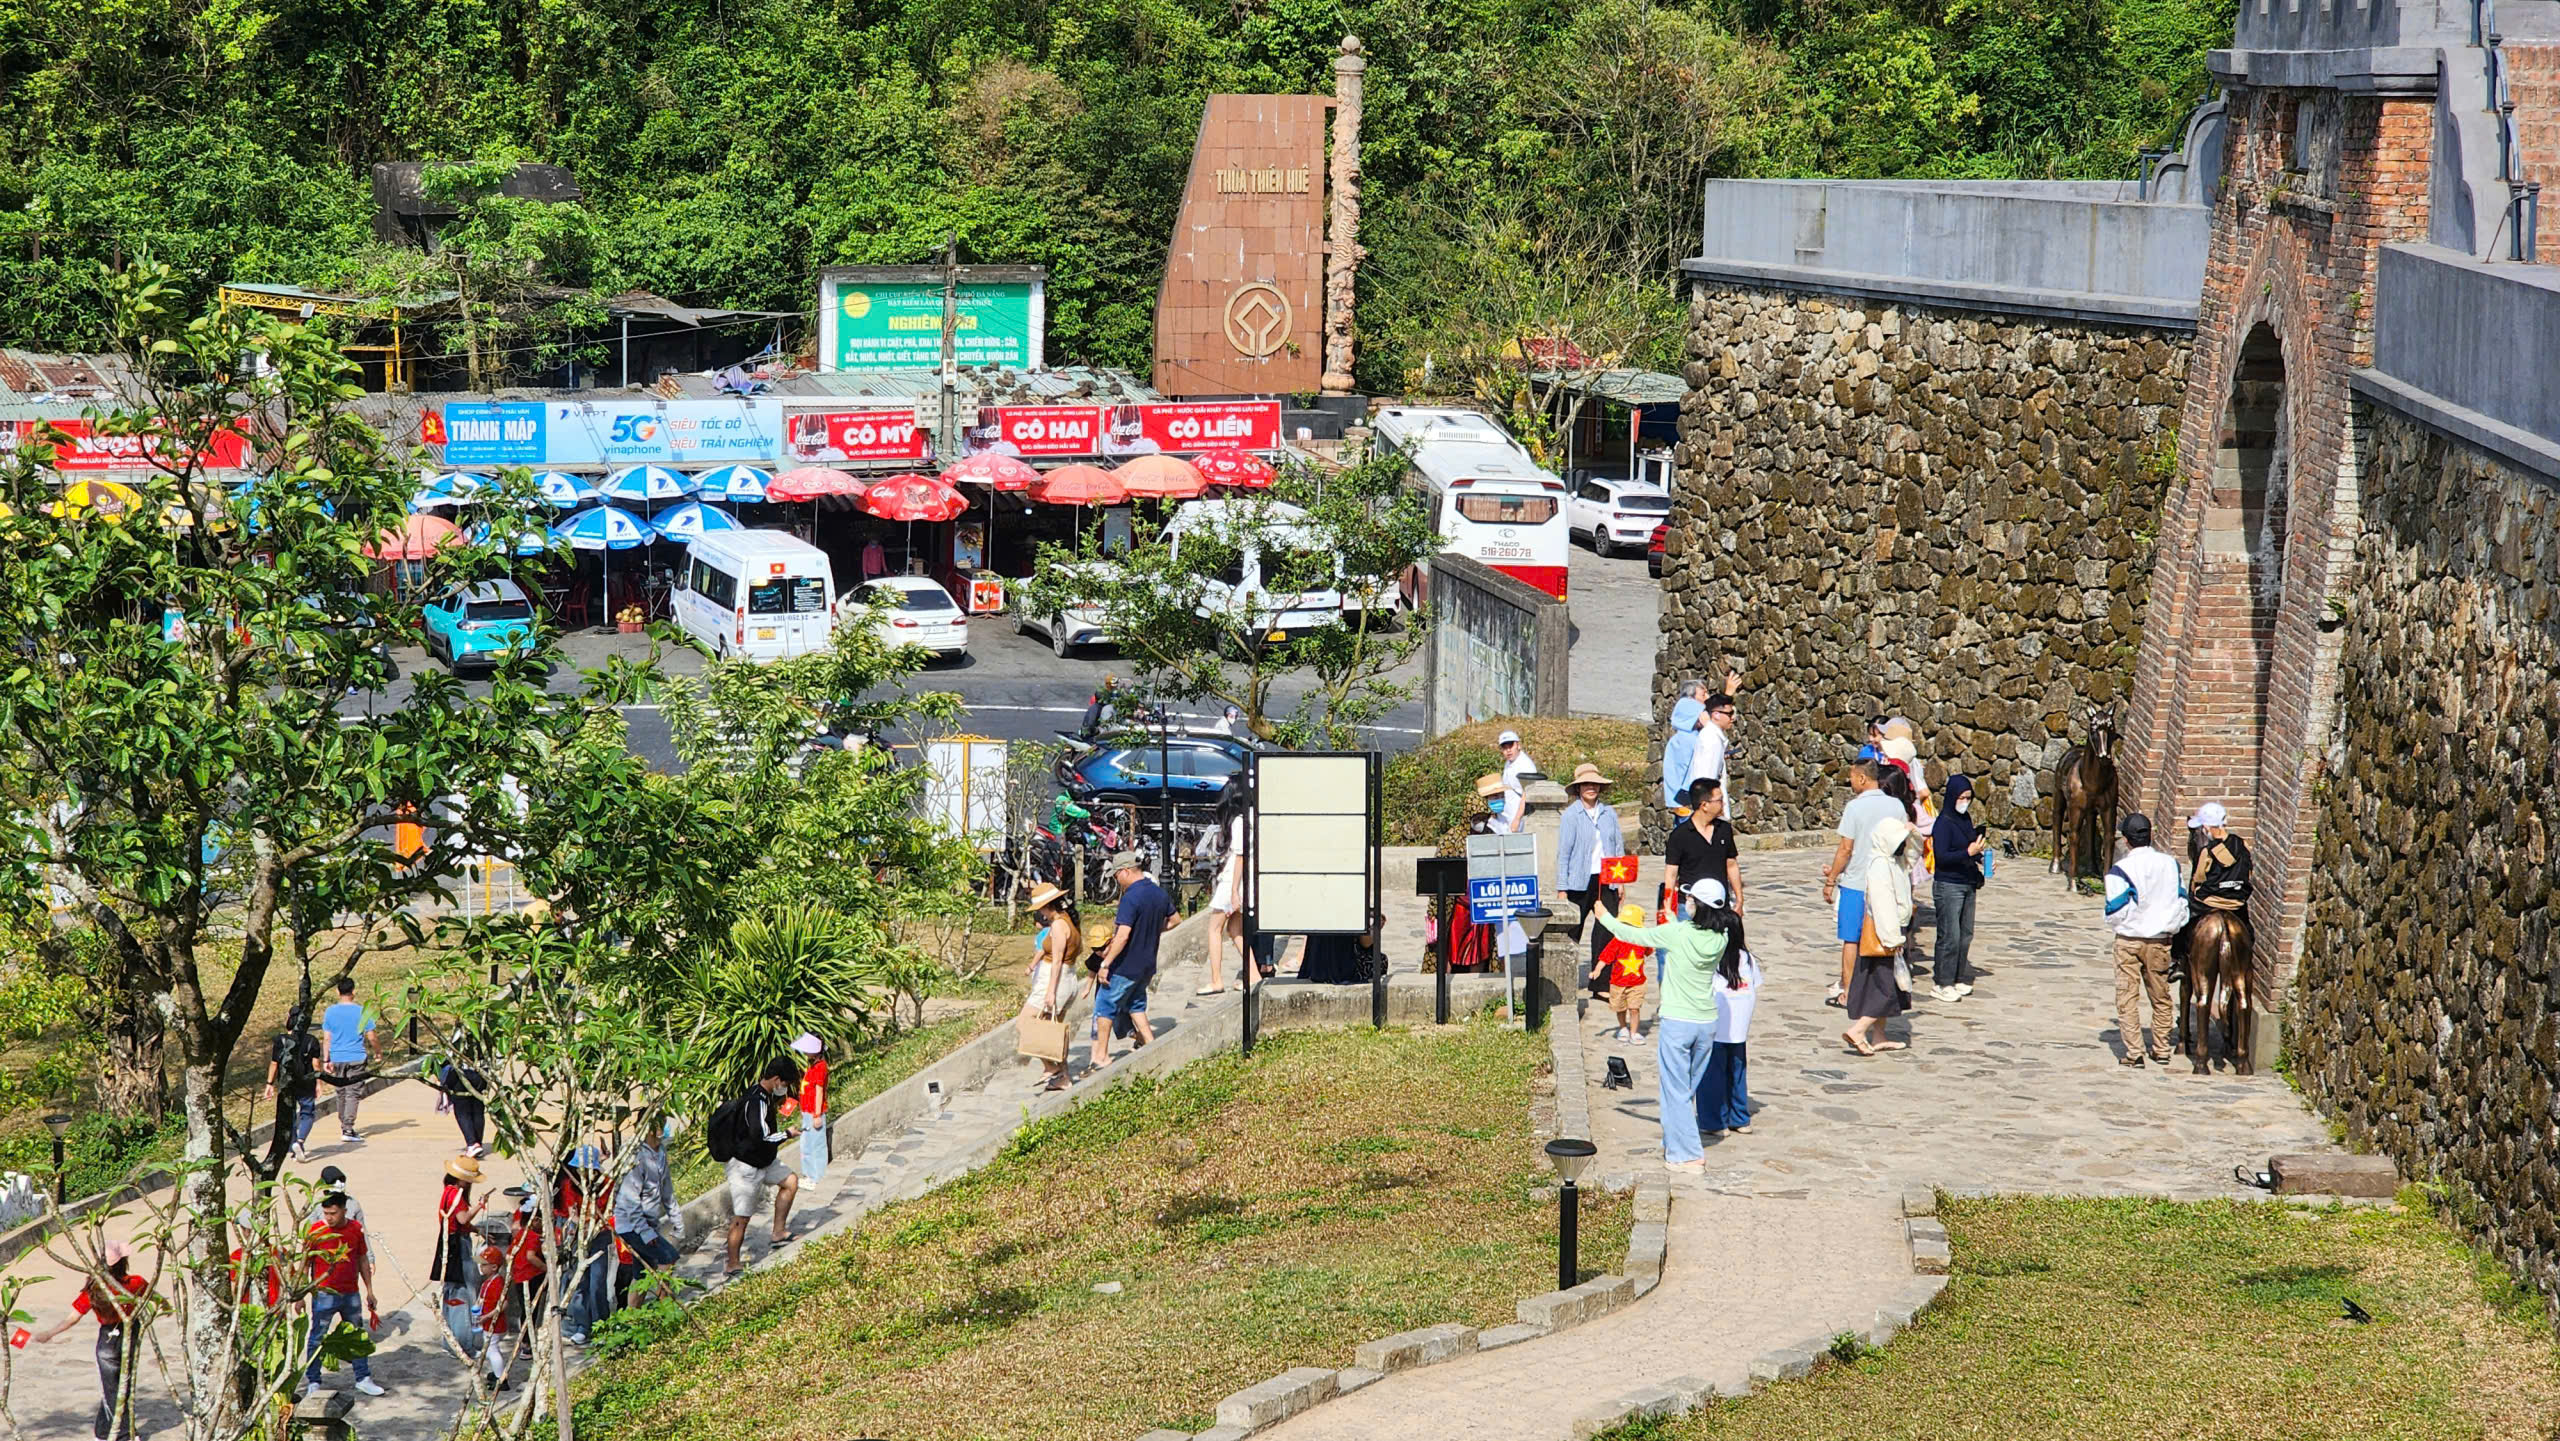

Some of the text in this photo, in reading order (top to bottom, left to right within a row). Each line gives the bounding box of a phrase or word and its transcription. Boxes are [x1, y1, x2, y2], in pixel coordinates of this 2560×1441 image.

[450, 416, 537, 444] THÀNH MẬP
[670, 416, 742, 431] SIÊU TỐC ĐỘ
[1013, 418, 1088, 439] CÔ HAI
[1168, 416, 1200, 439] CÔ
[701, 436, 725, 448] TRẢI
[729, 435, 774, 449] NGHIỆM
[843, 421, 915, 446] CÔ MỸ
[604, 445, 661, 455] vinaphone
[1480, 882, 1499, 897] LỐI
